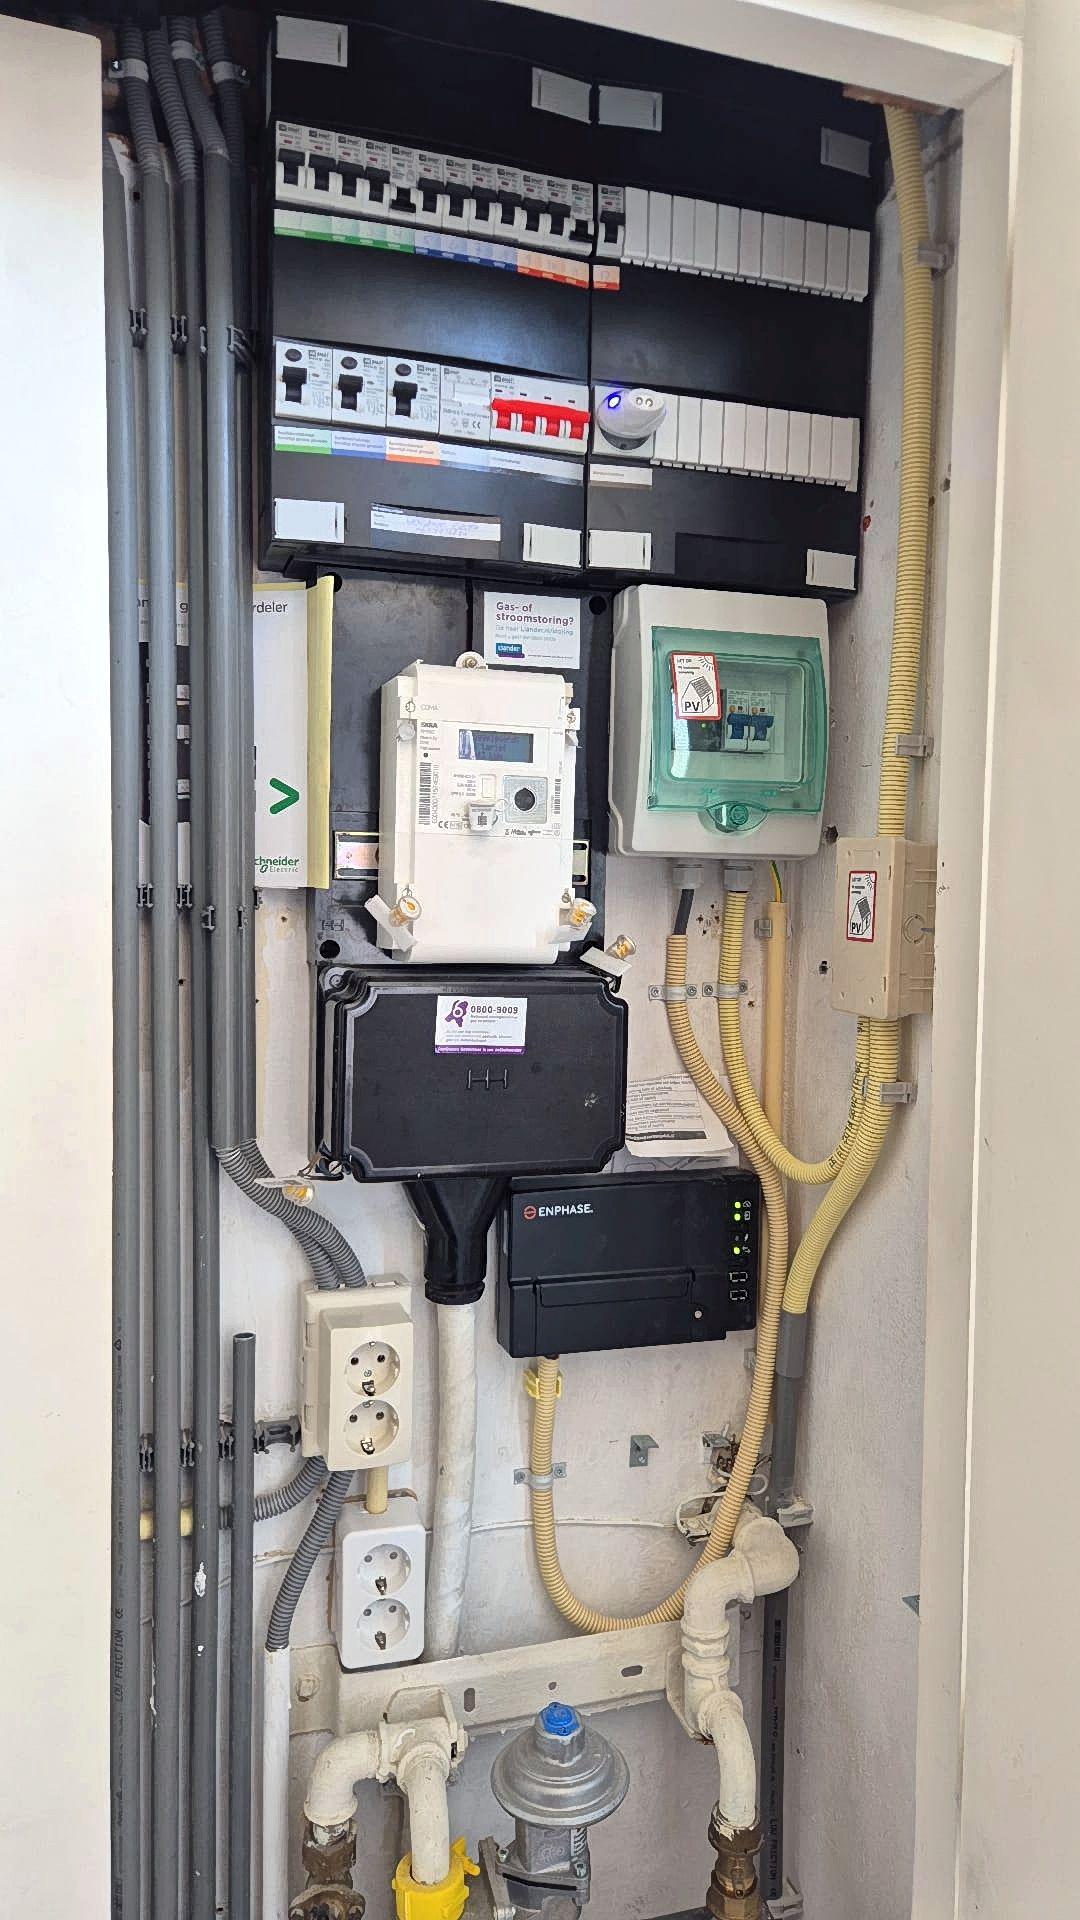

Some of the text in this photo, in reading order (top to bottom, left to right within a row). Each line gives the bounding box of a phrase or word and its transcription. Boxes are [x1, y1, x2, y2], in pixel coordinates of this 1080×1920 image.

[496, 601, 533, 612] Gas- of
[496, 612, 574, 627] stroomstoring?
[684, 701, 700, 712] PV
[254, 856, 300, 866] chneider
[851, 922, 861, 934] PV
[470, 1005, 519, 1014] 0800-9009
